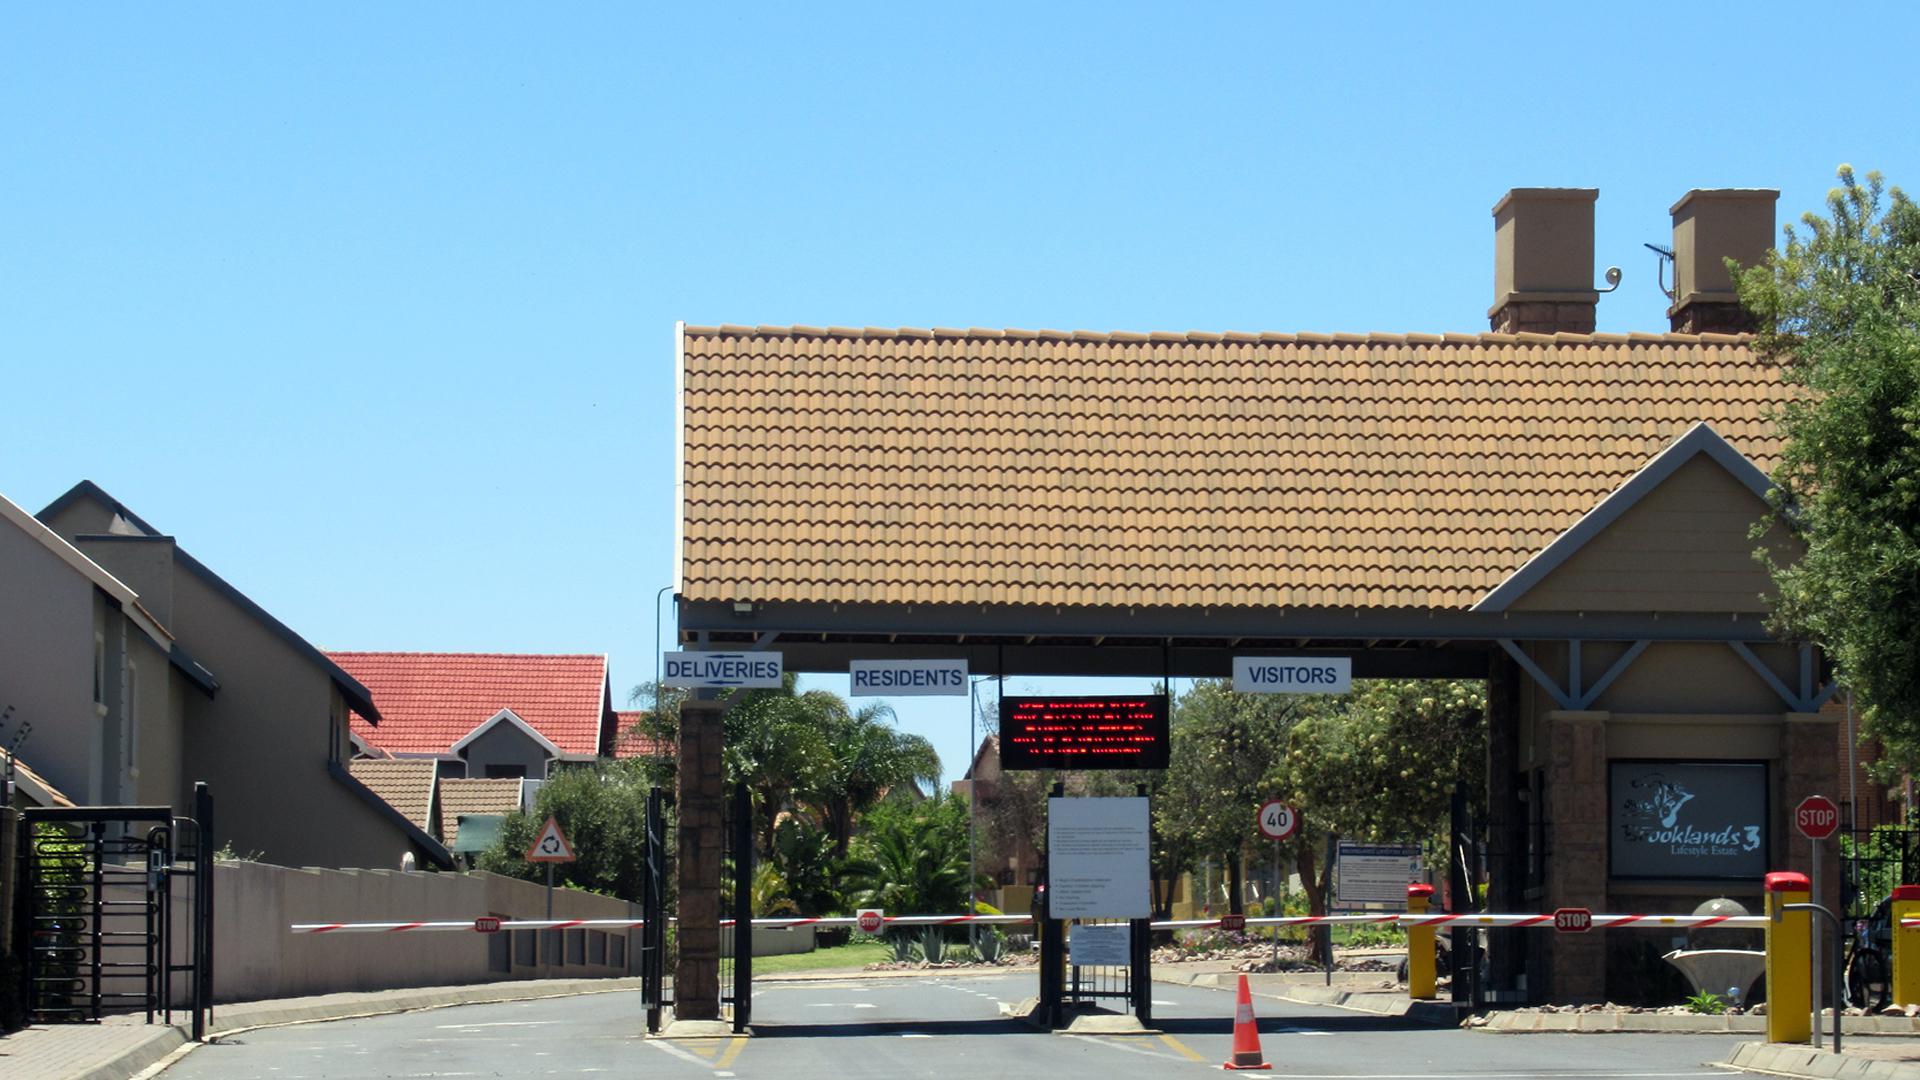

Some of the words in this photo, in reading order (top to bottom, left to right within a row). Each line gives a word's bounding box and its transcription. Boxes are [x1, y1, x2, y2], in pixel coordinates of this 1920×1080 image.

[667, 661, 779, 678] DELIVERIES
[855, 669, 962, 686] RESIDENTS
[1248, 666, 1337, 684] VISITORS
[1267, 812, 1287, 827] 40
[1799, 810, 1834, 826] STOP
[1622, 824, 1741, 845] ooklands
[1742, 825, 1761, 852] 3
[477, 920, 497, 929] STOP
[860, 917, 880, 926] STOP
[1558, 913, 1589, 927] STOP
